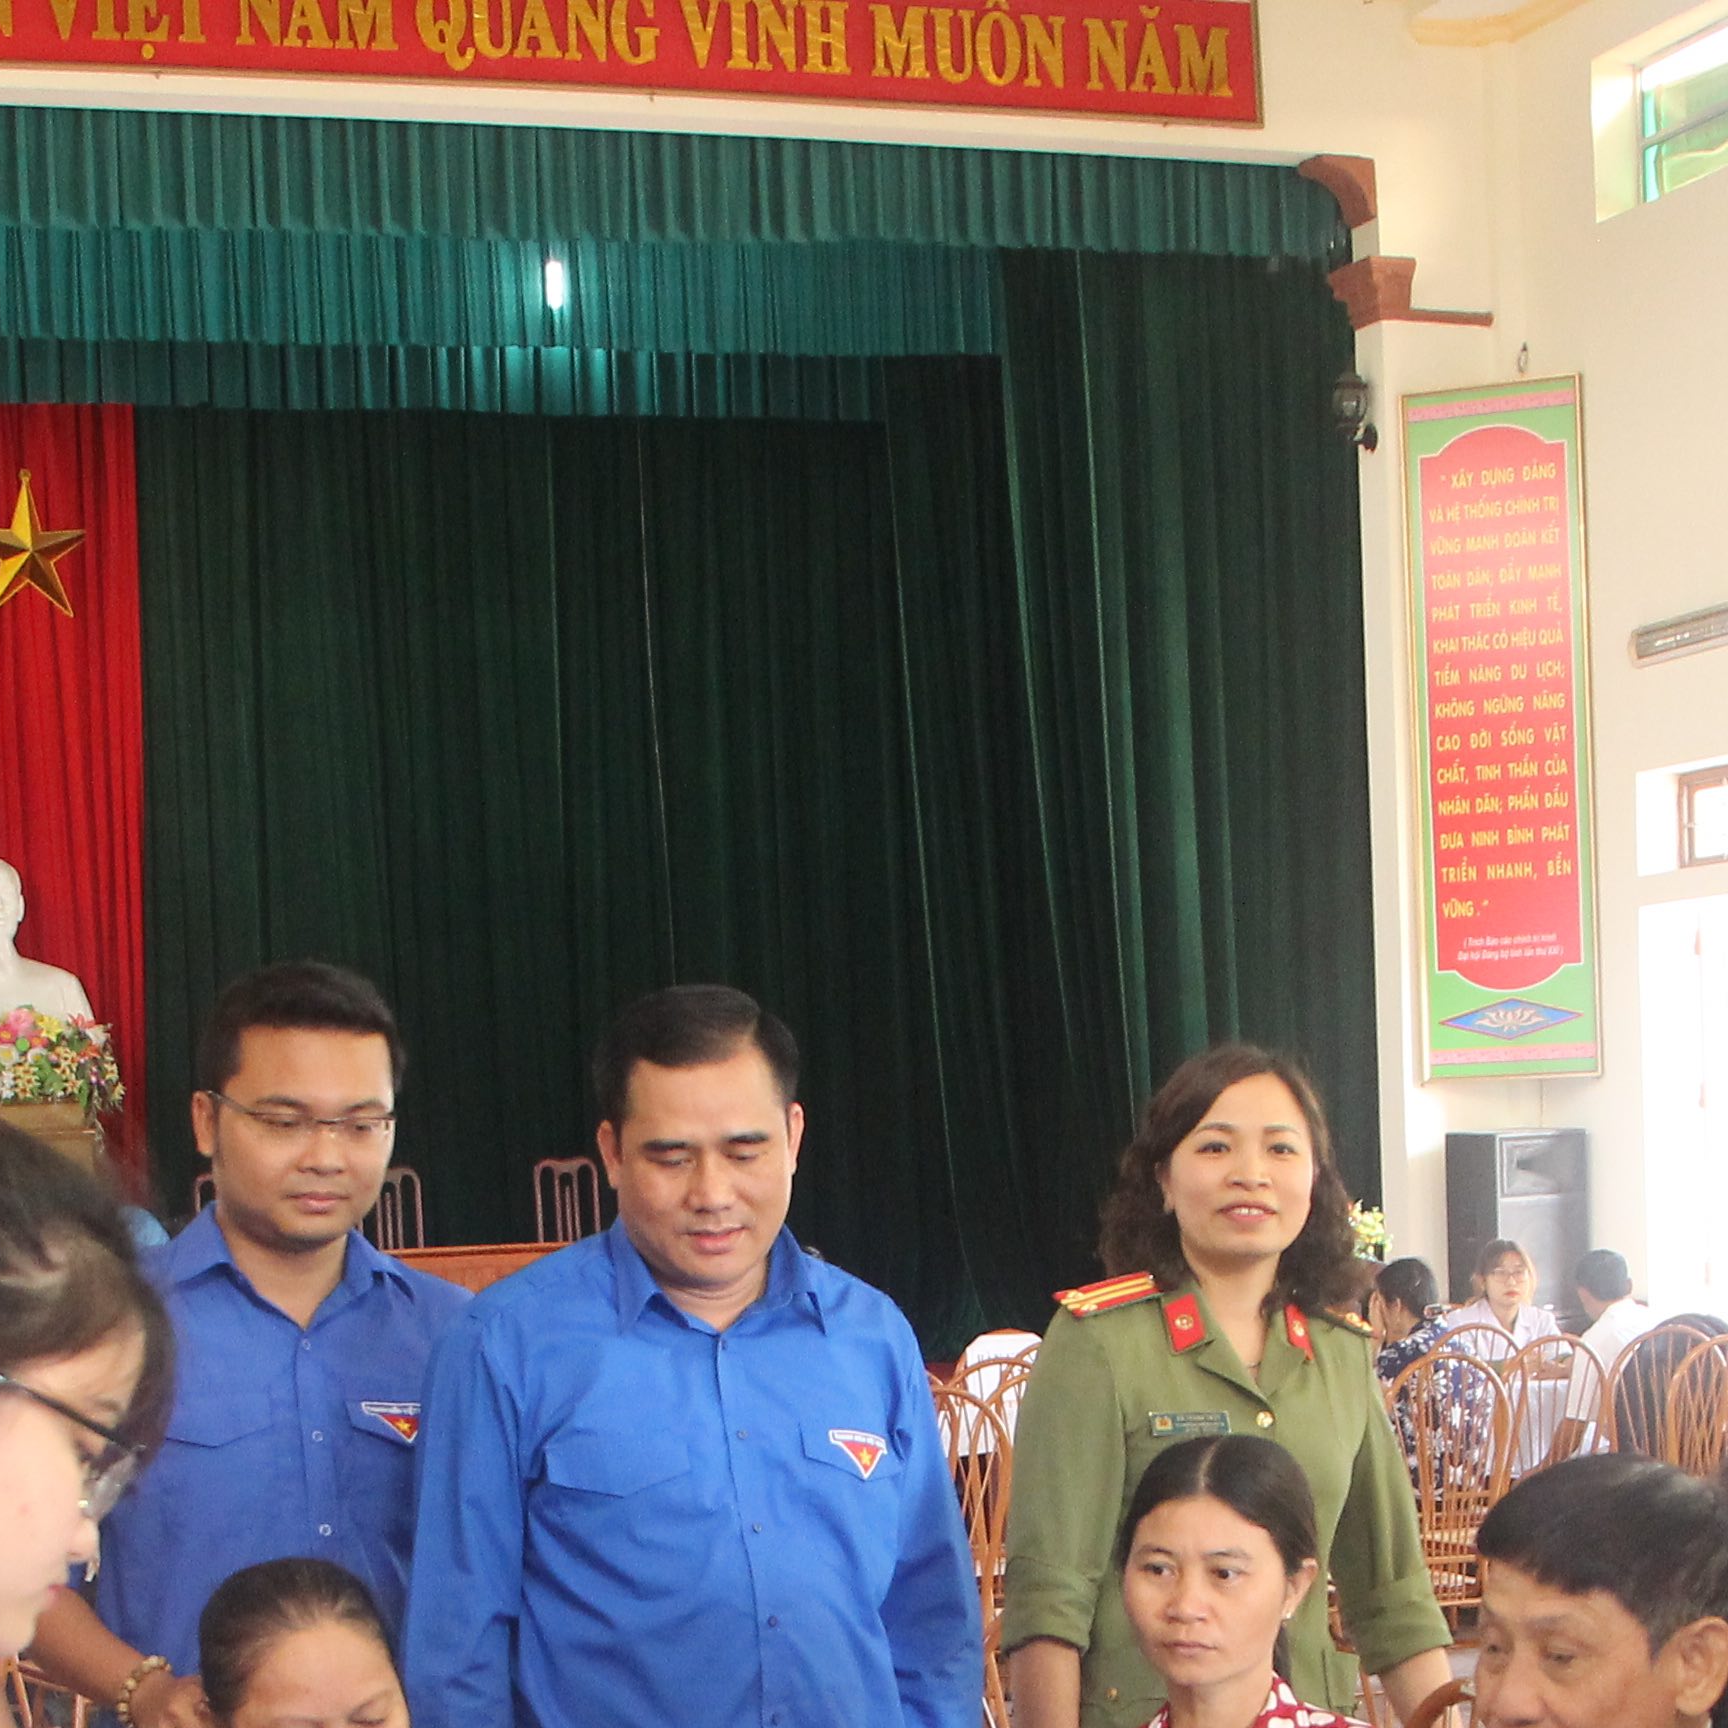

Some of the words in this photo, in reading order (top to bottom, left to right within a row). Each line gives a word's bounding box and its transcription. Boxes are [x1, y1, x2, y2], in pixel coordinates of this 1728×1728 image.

[236, 0, 399, 51] NAM
[415, 0, 660, 71] QUANG
[677, 0, 852, 75] VINH
[873, 1, 1066, 88] MUÔN
[1084, 6, 1234, 98] NĂM
[1451, 468, 1473, 489] XÂY
[1481, 467, 1515, 489] DỰNG
[1522, 459, 1557, 481] ĐẢNG
[1511, 664, 1527, 680] DU
[1434, 697, 1475, 718] KHÔNG
[1436, 735, 1461, 752] CAO
[1501, 721, 1535, 747] SỐNG
[1544, 722, 1567, 747] VẬT
[1475, 764, 1502, 781] TINH
[1544, 753, 1568, 776] CỦA
[1438, 795, 1470, 816] NHÂN
[1440, 831, 1464, 850] ĐƯA
[1471, 830, 1500, 847] NINH
[1507, 823, 1535, 845] BÌNH
[1541, 820, 1570, 843] PHÁT
[1441, 856, 1477, 883] TRIỂN
